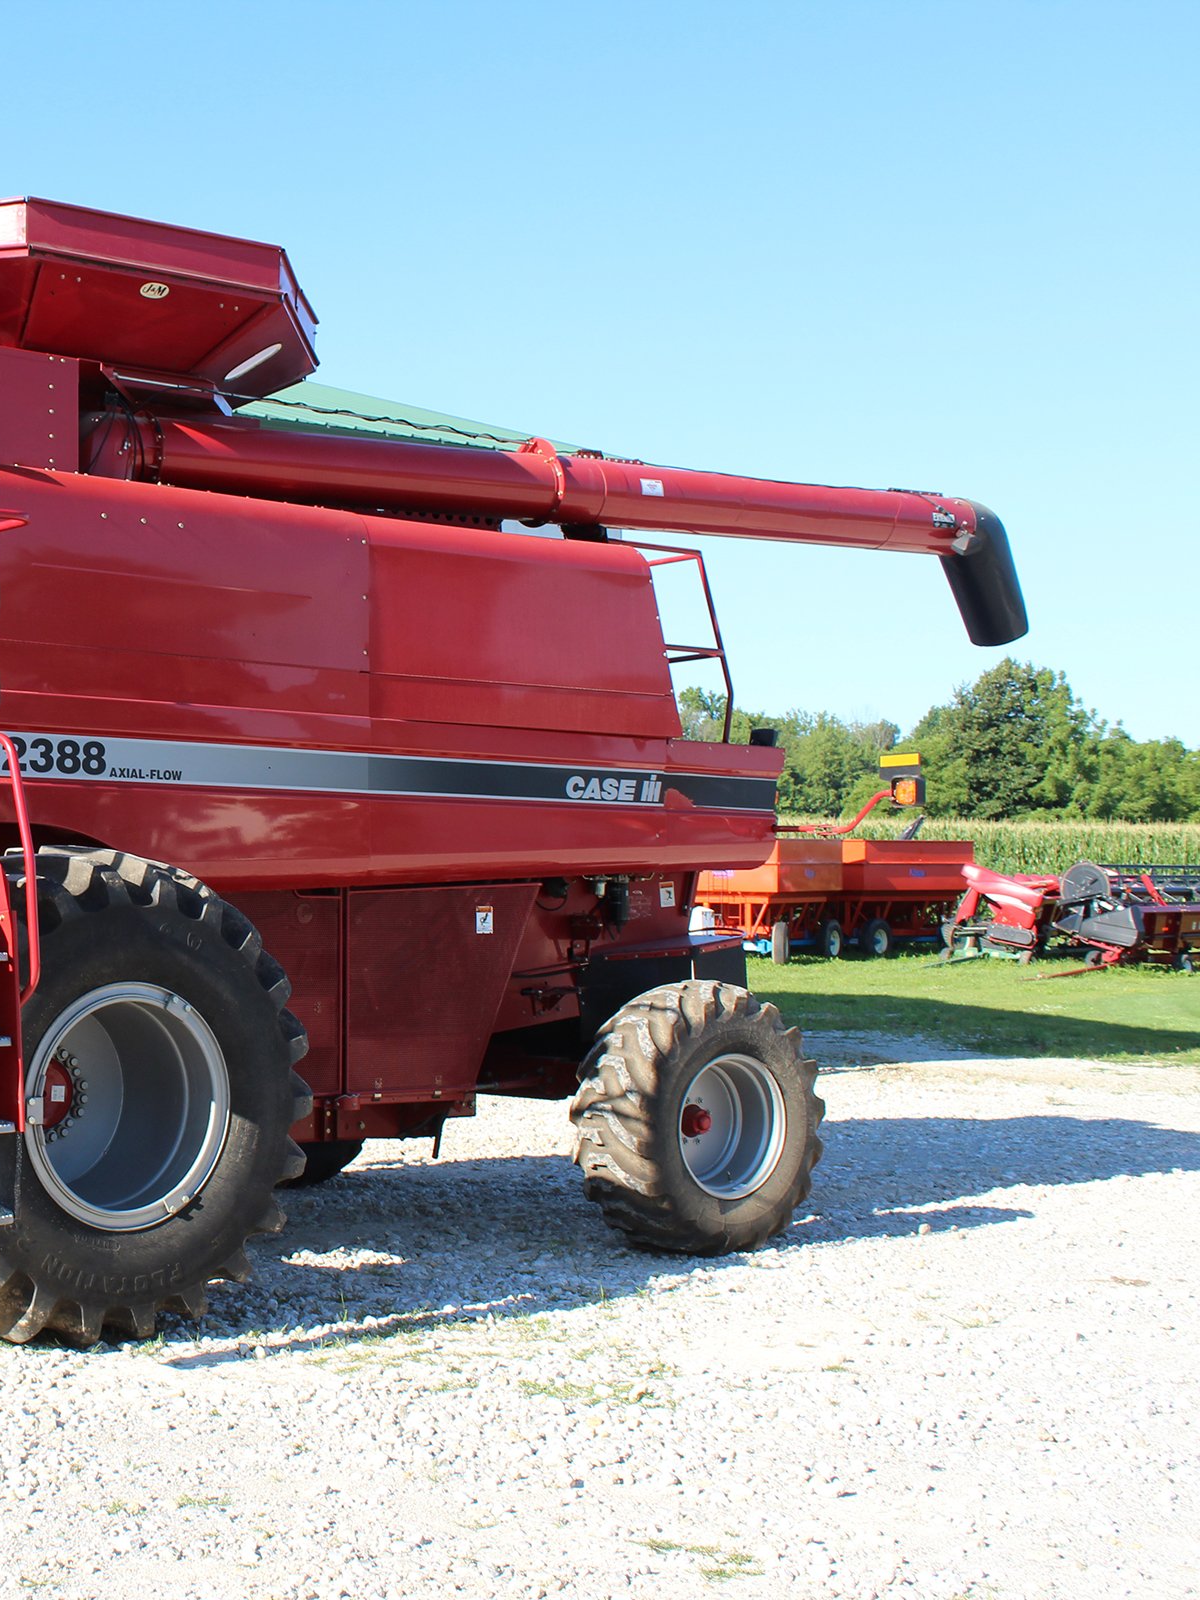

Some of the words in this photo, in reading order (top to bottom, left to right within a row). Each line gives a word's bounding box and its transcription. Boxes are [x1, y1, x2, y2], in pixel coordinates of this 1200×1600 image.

[143, 284, 167, 296] J&M
[1, 736, 106, 774] 2388
[109, 767, 182, 781] AXIAL-FLOW
[565, 775, 637, 801] CASE
